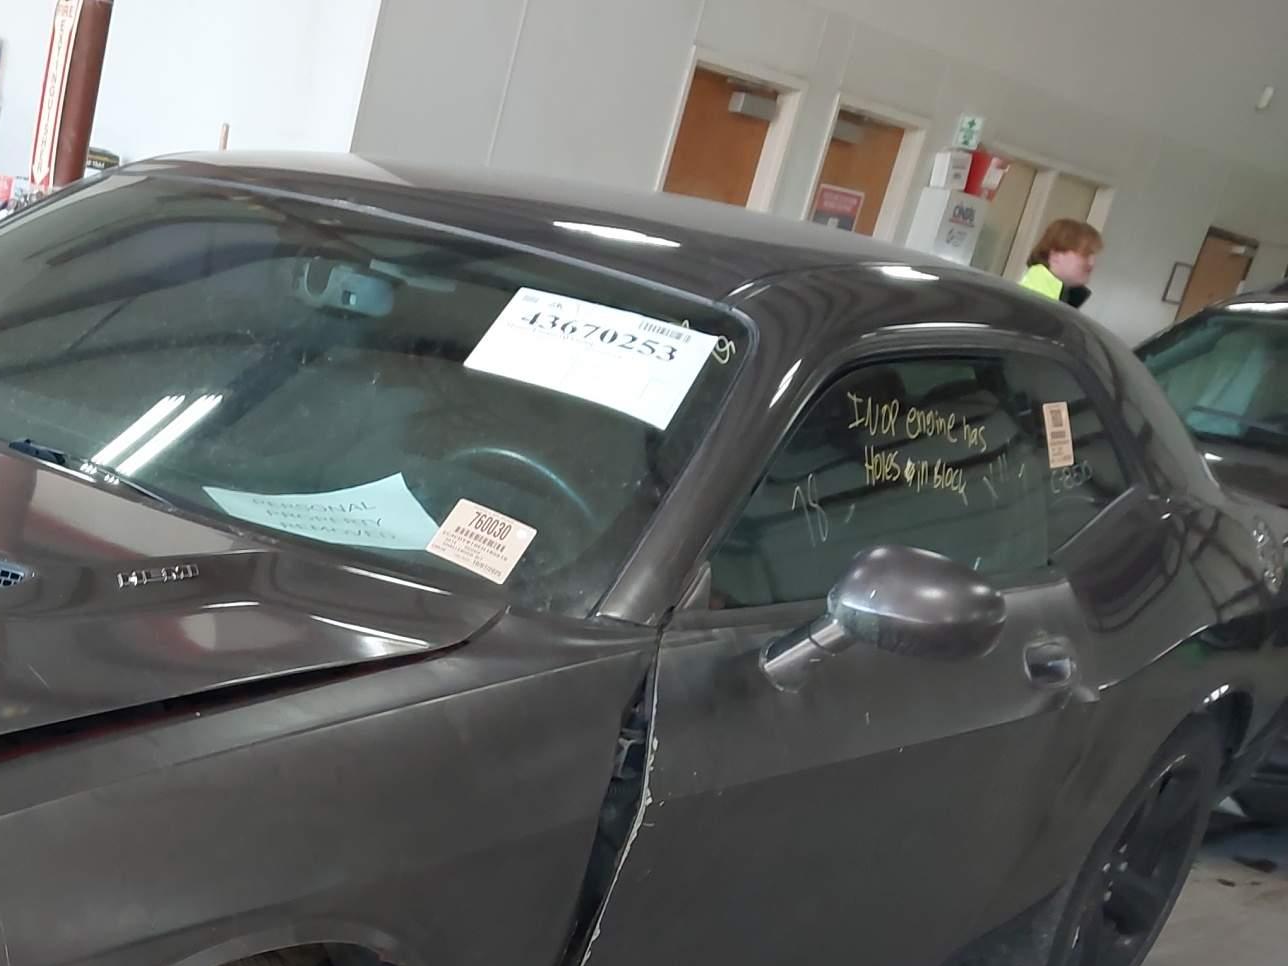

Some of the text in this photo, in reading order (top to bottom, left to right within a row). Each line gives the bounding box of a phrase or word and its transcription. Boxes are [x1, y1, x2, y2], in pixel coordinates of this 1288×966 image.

[520, 311, 678, 362] 43670253
[847, 391, 987, 453] INOP engine has
[865, 445, 901, 487] Holes
[467, 511, 513, 541] 760030
